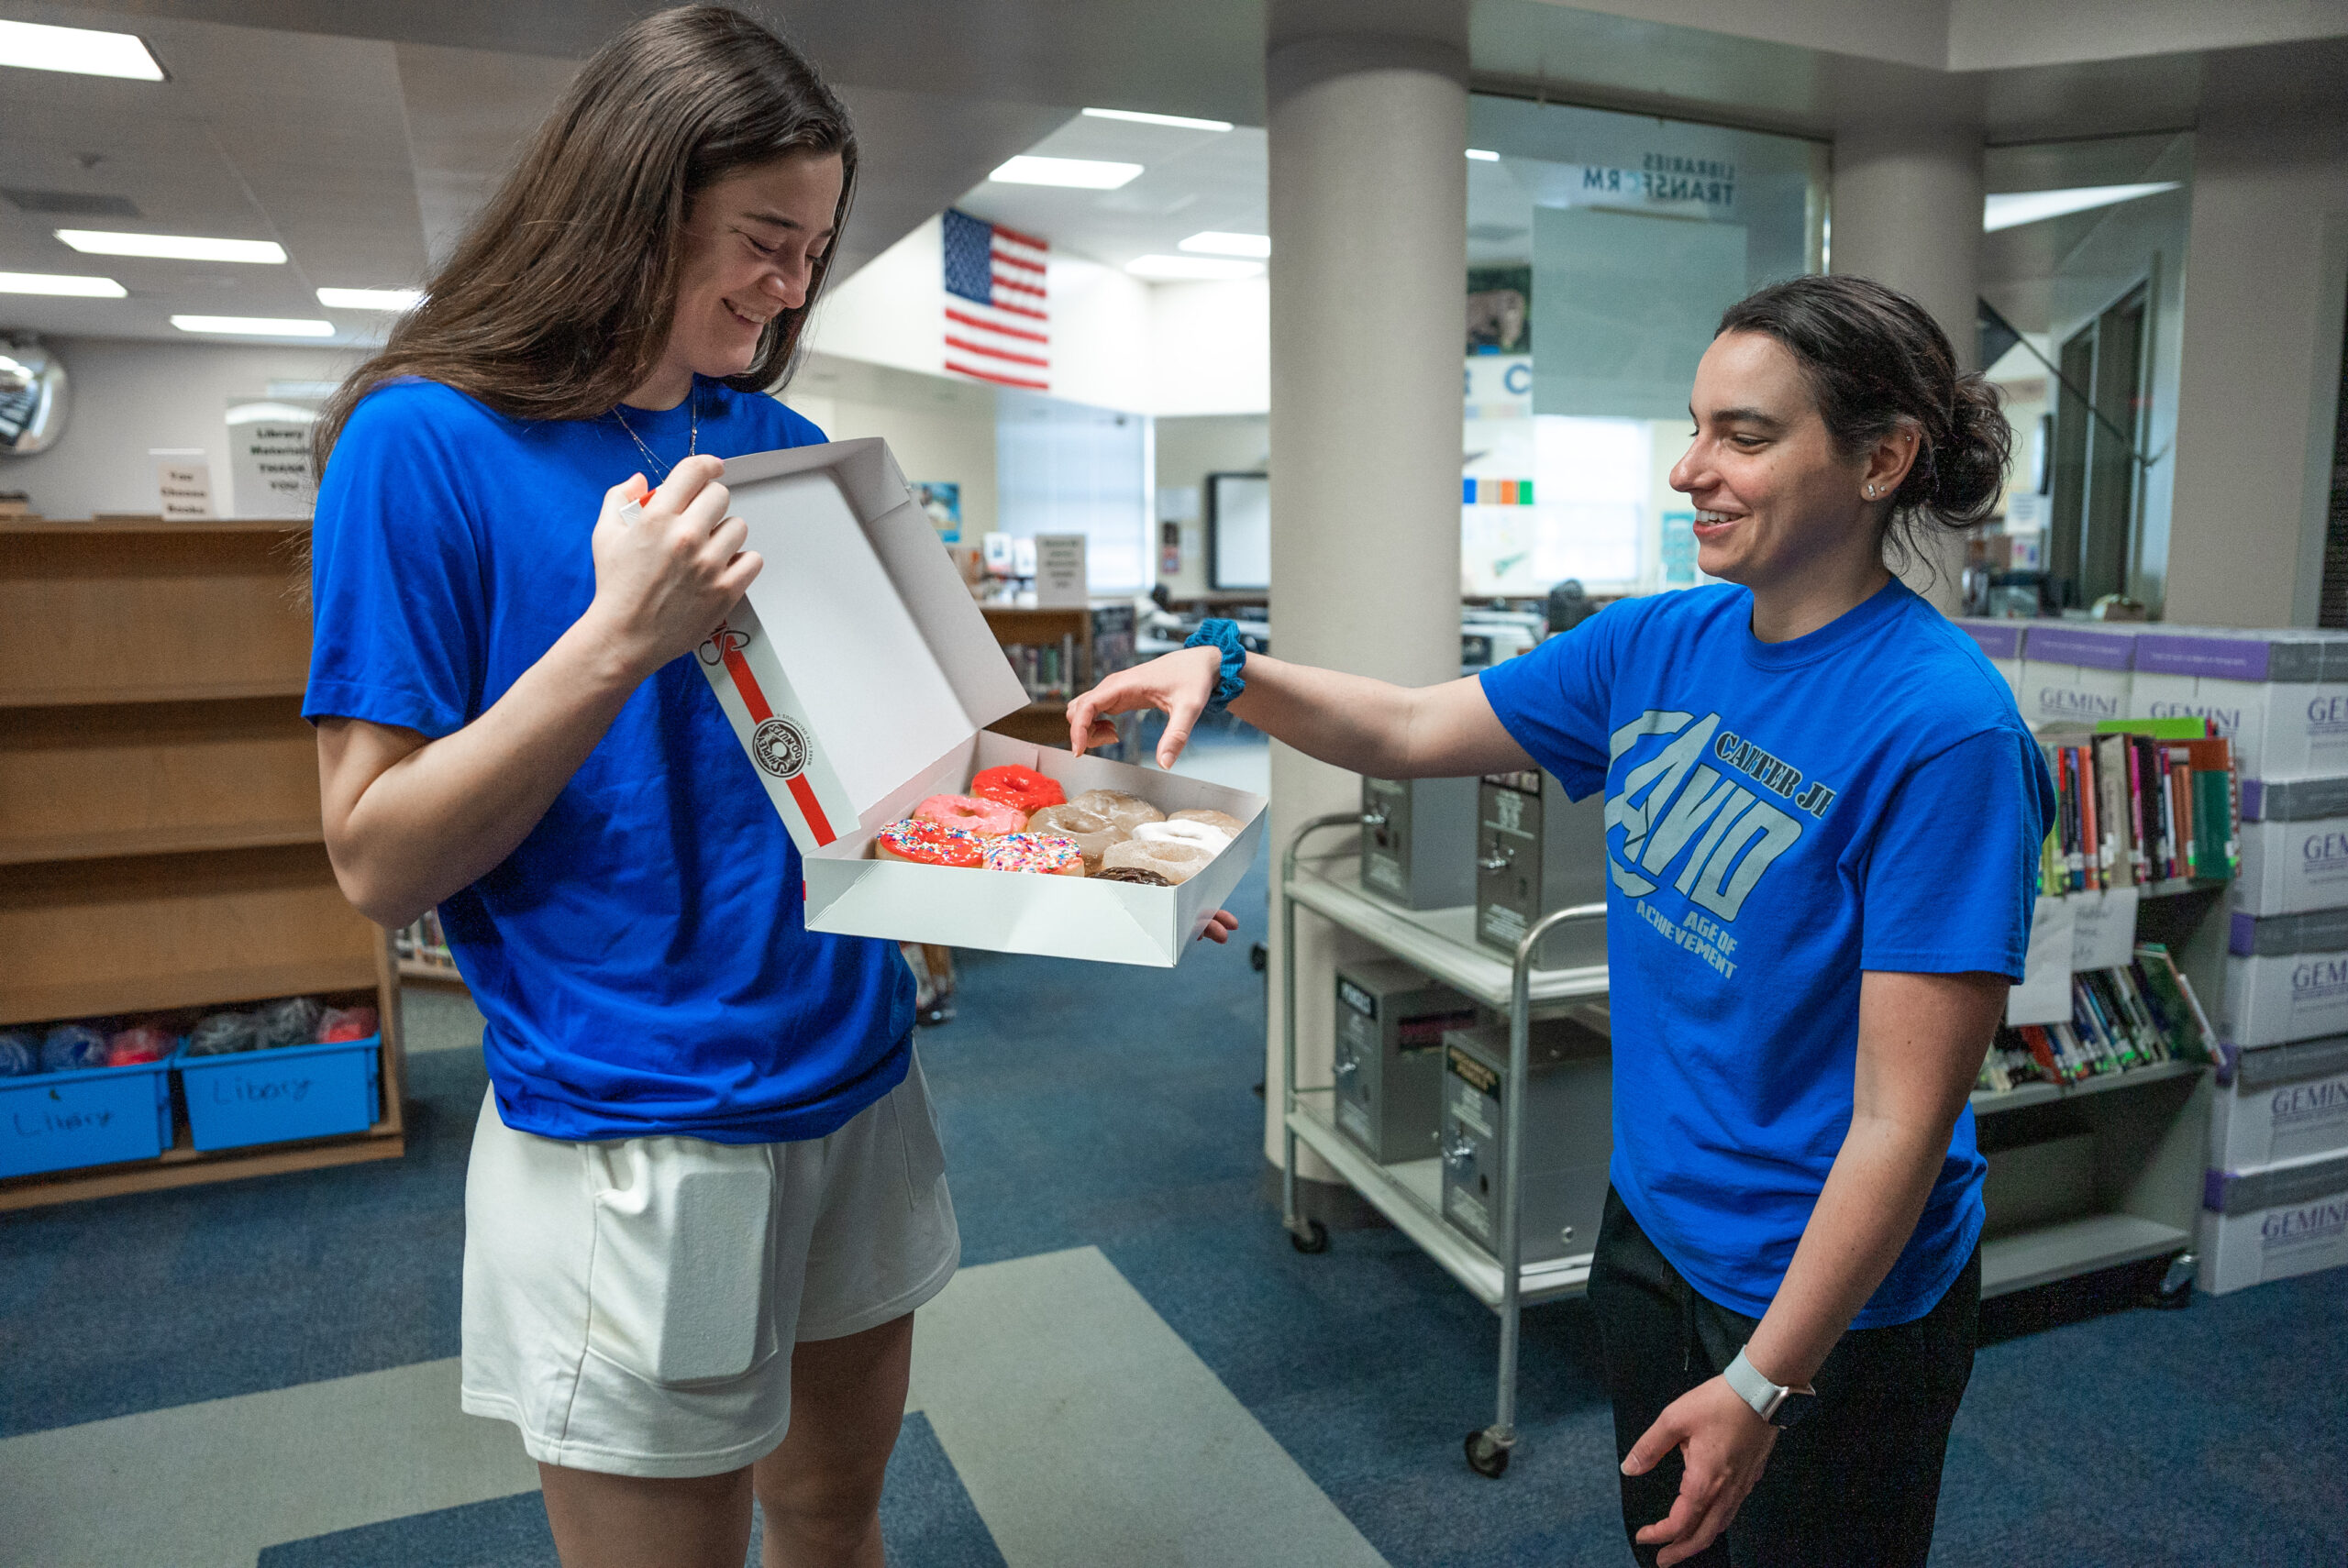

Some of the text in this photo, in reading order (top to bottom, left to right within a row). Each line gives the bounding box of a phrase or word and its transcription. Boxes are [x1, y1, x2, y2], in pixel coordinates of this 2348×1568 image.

[260, 463, 305, 473] THANK
[271, 480, 299, 490] YOU
[2039, 687, 2118, 715] GEMINI
[2307, 696, 2348, 723] GE
[757, 736, 788, 775] SHIPLEY
[1622, 712, 1804, 924] AVID
[1636, 900, 1738, 980] ACHIEVEMENT
[1682, 911, 1738, 956] AGE OF
